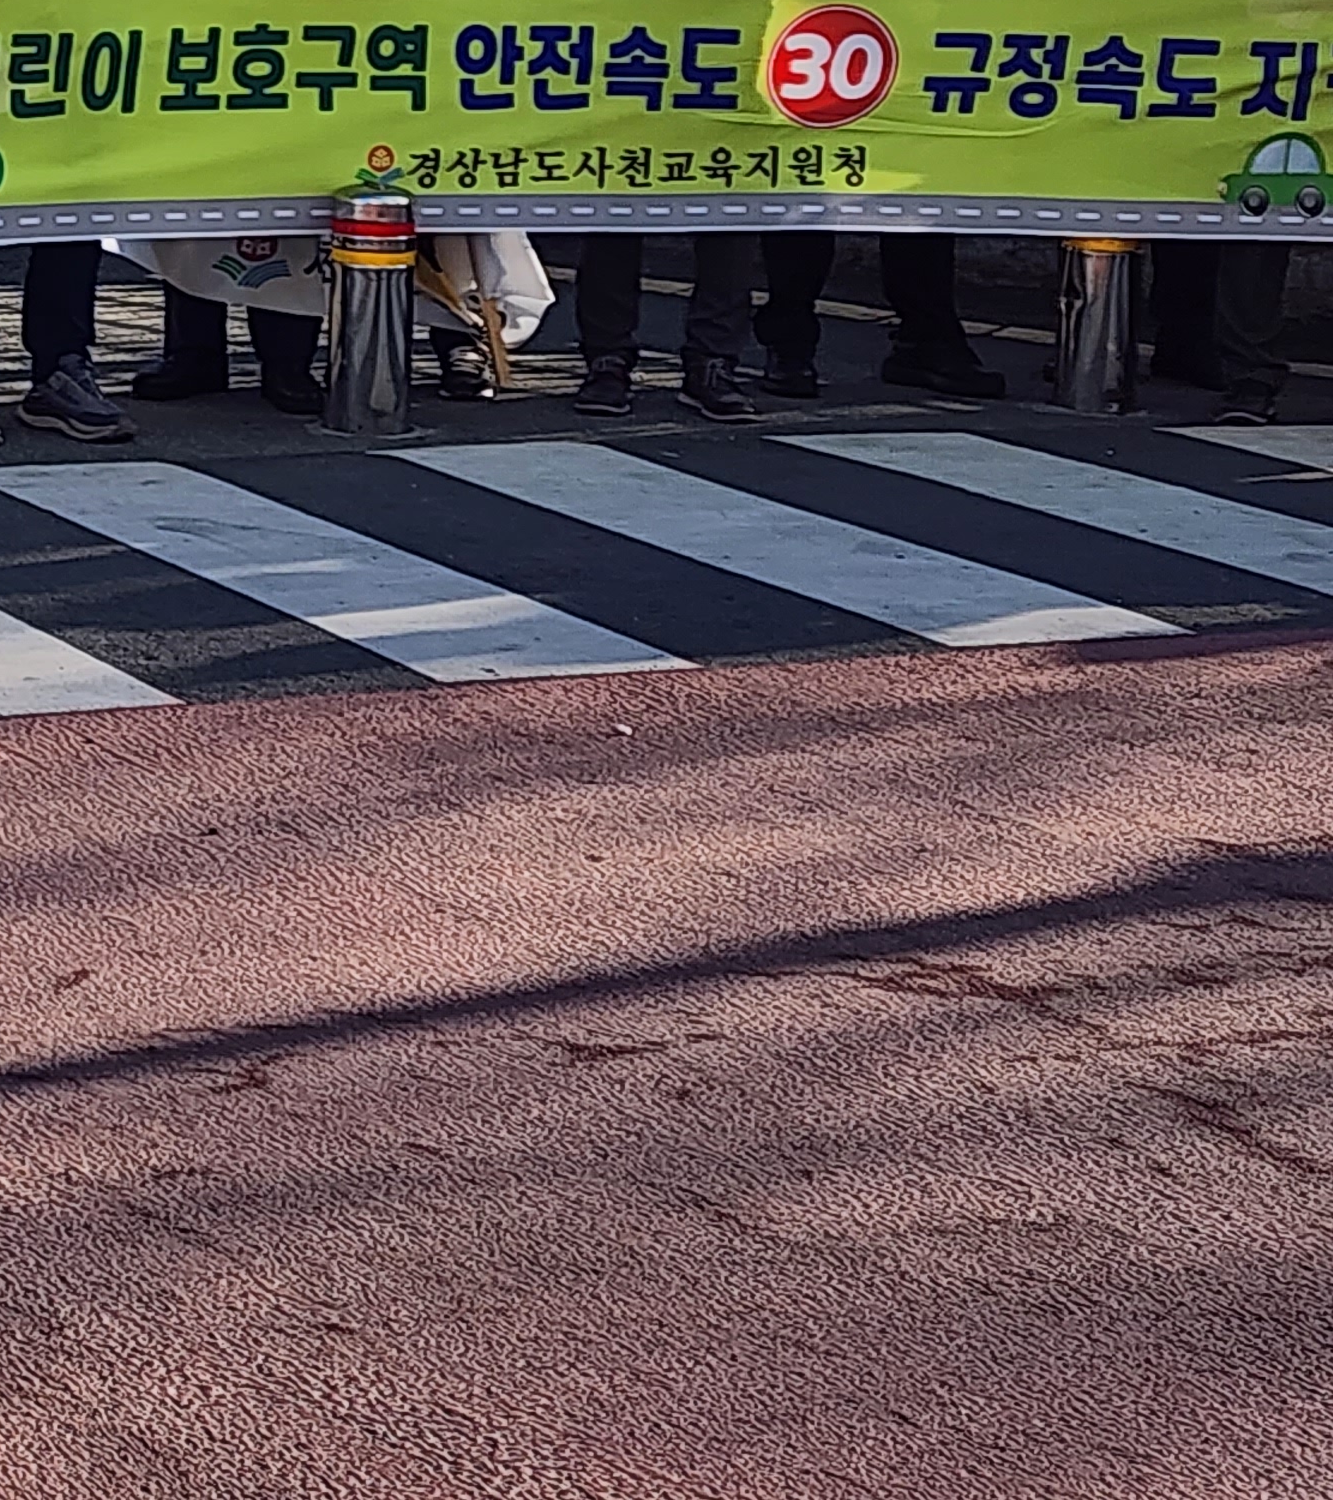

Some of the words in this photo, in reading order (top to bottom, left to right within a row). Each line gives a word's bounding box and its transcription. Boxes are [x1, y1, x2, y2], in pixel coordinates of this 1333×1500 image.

[159, 23, 430, 113] 보호구역
[454, 24, 741, 113] 안전속도
[780, 32, 885, 101] 30
[923, 32, 1221, 121] 규정속도
[406, 145, 869, 191] 경상남도사천교육지원청
